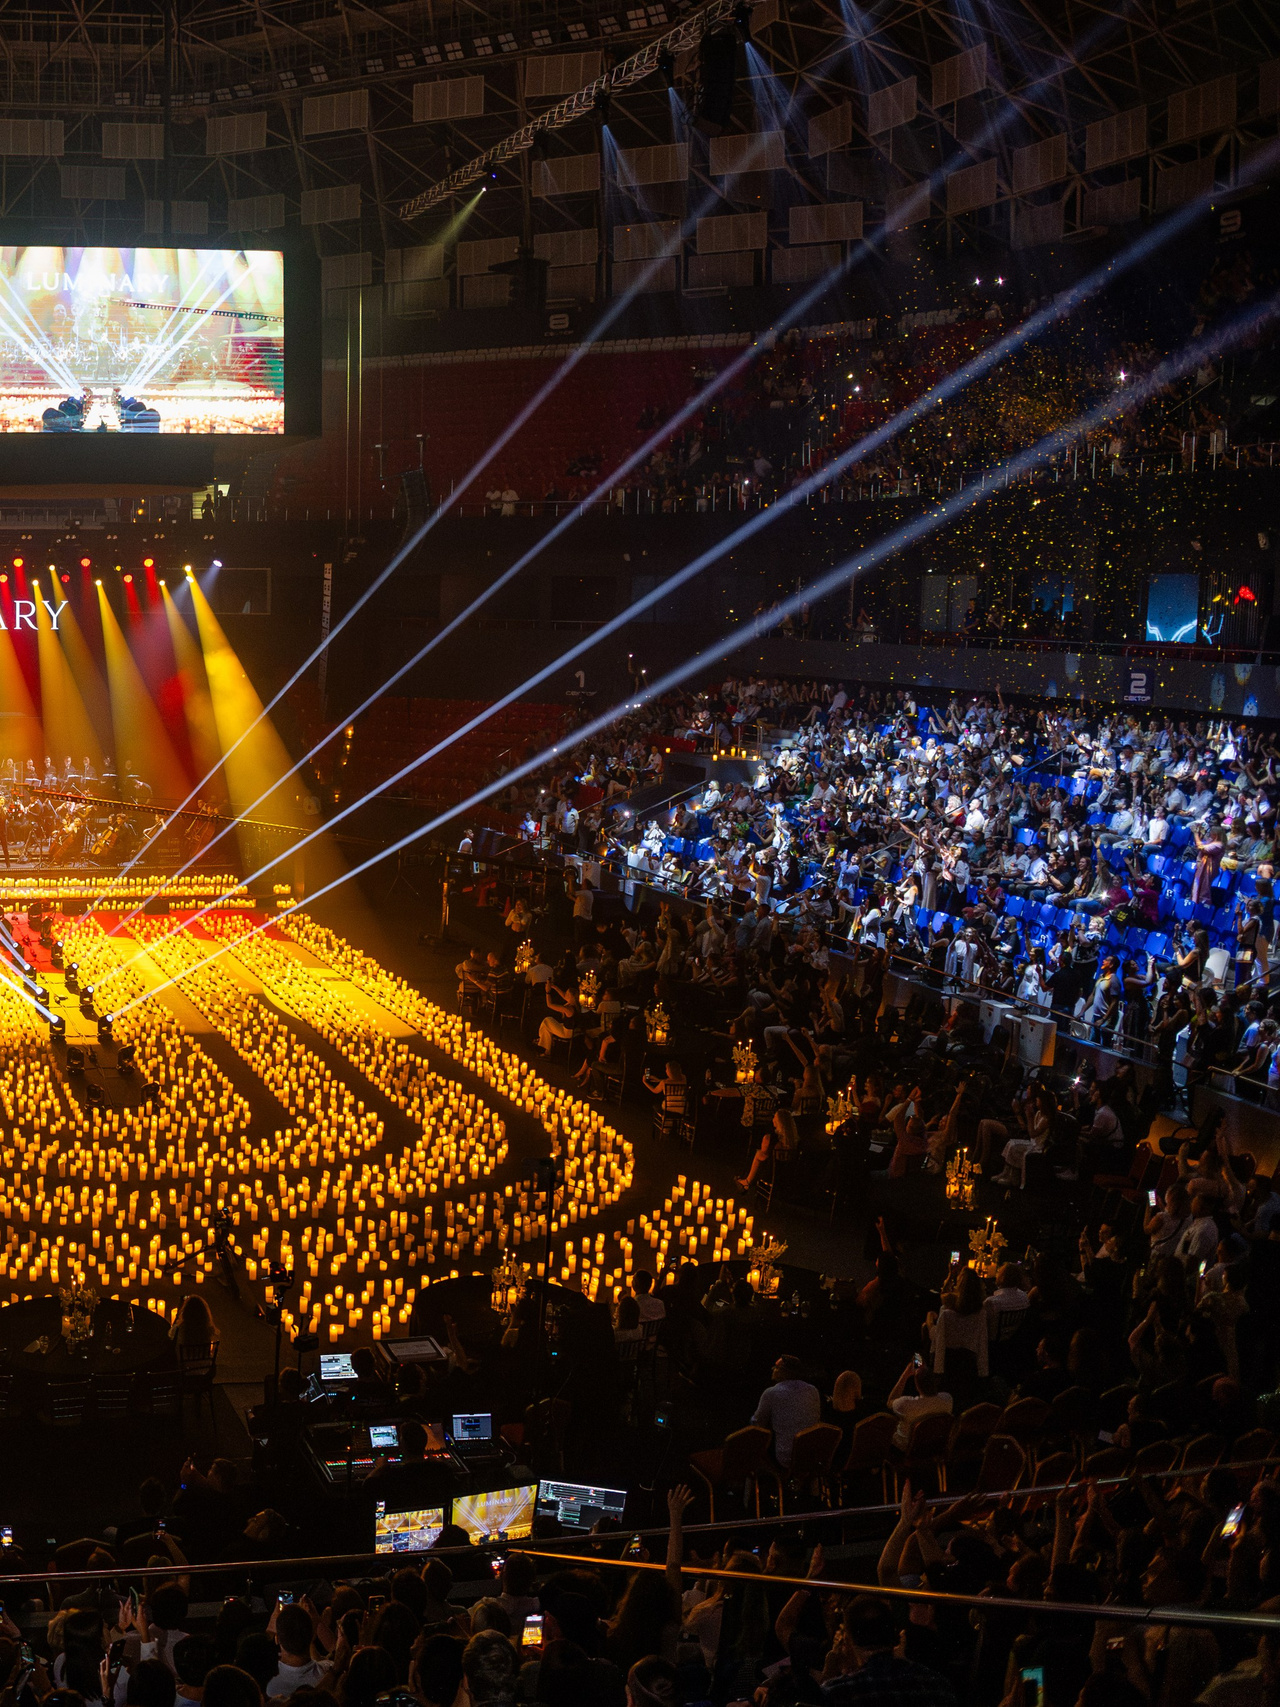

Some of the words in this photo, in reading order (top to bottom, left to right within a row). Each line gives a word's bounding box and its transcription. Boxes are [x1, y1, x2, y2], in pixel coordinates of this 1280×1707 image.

[1220, 210, 1241, 235] 9
[27, 271, 169, 293] LUMNARY
[549, 313, 569, 330] 8
[574, 670, 585, 688] 1
[1130, 672, 1146, 694] 2
